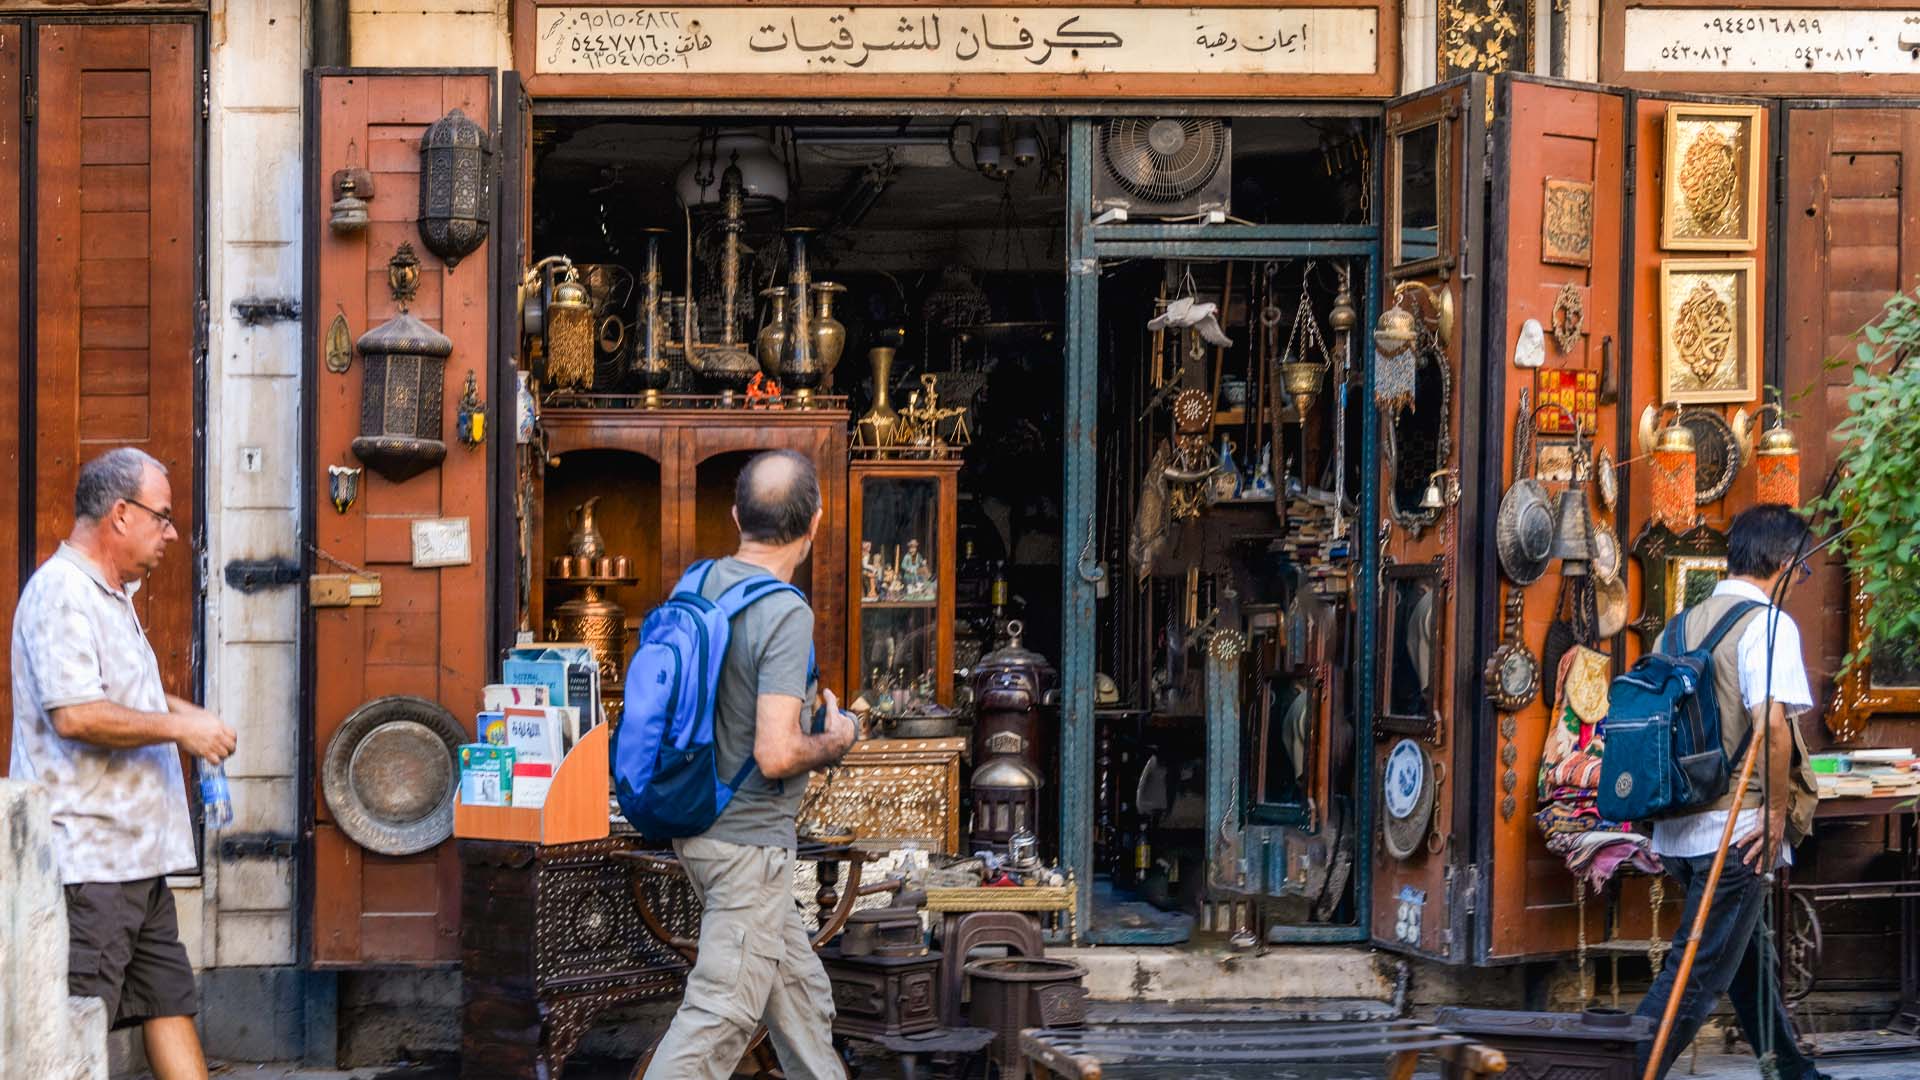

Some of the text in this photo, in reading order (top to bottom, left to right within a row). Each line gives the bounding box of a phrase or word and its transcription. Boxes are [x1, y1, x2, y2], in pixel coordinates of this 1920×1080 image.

[1704, 18, 1822, 33] ٠٩٤٤٥١٦٨٩٩
[571, 34, 658, 51] ٥٤٤٧٧١٦
[749, 13, 1123, 68] كرفان للشرقيات
[1196, 25, 1237, 57] وهبة
